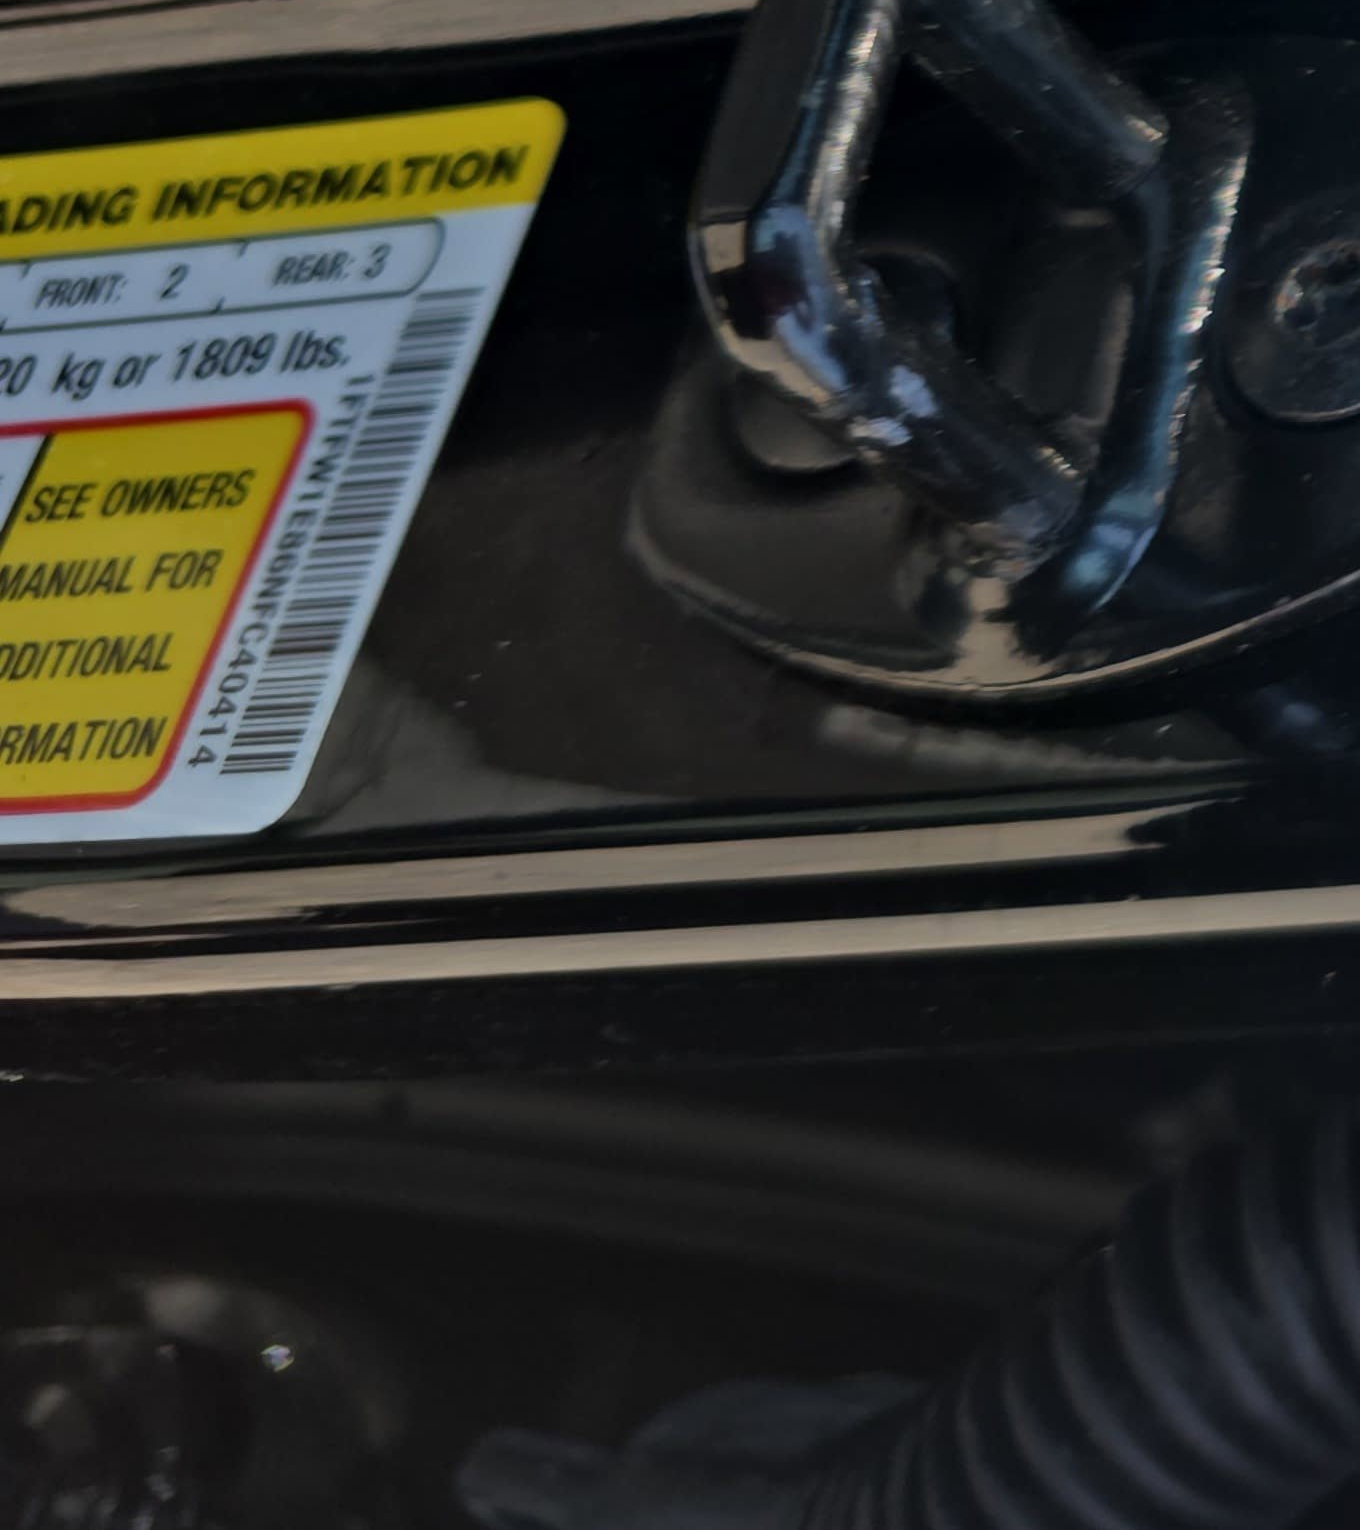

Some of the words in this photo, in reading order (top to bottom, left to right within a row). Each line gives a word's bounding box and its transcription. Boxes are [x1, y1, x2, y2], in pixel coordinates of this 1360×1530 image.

[150, 144, 530, 222] INFORMATION
[33, 273, 128, 309] FRONT:
[157, 263, 190, 302] 2
[271, 251, 355, 287] REAR:
[362, 243, 392, 279] 3
[52, 352, 105, 401] kg
[110, 354, 162, 389] or
[170, 331, 277, 382] 1809
[279, 329, 352, 375] lbs.
[25, 482, 97, 523] SEE
[101, 469, 256, 517] OWNERS
[0, 556, 135, 602] MANUAL
[145, 548, 224, 592] FOR
